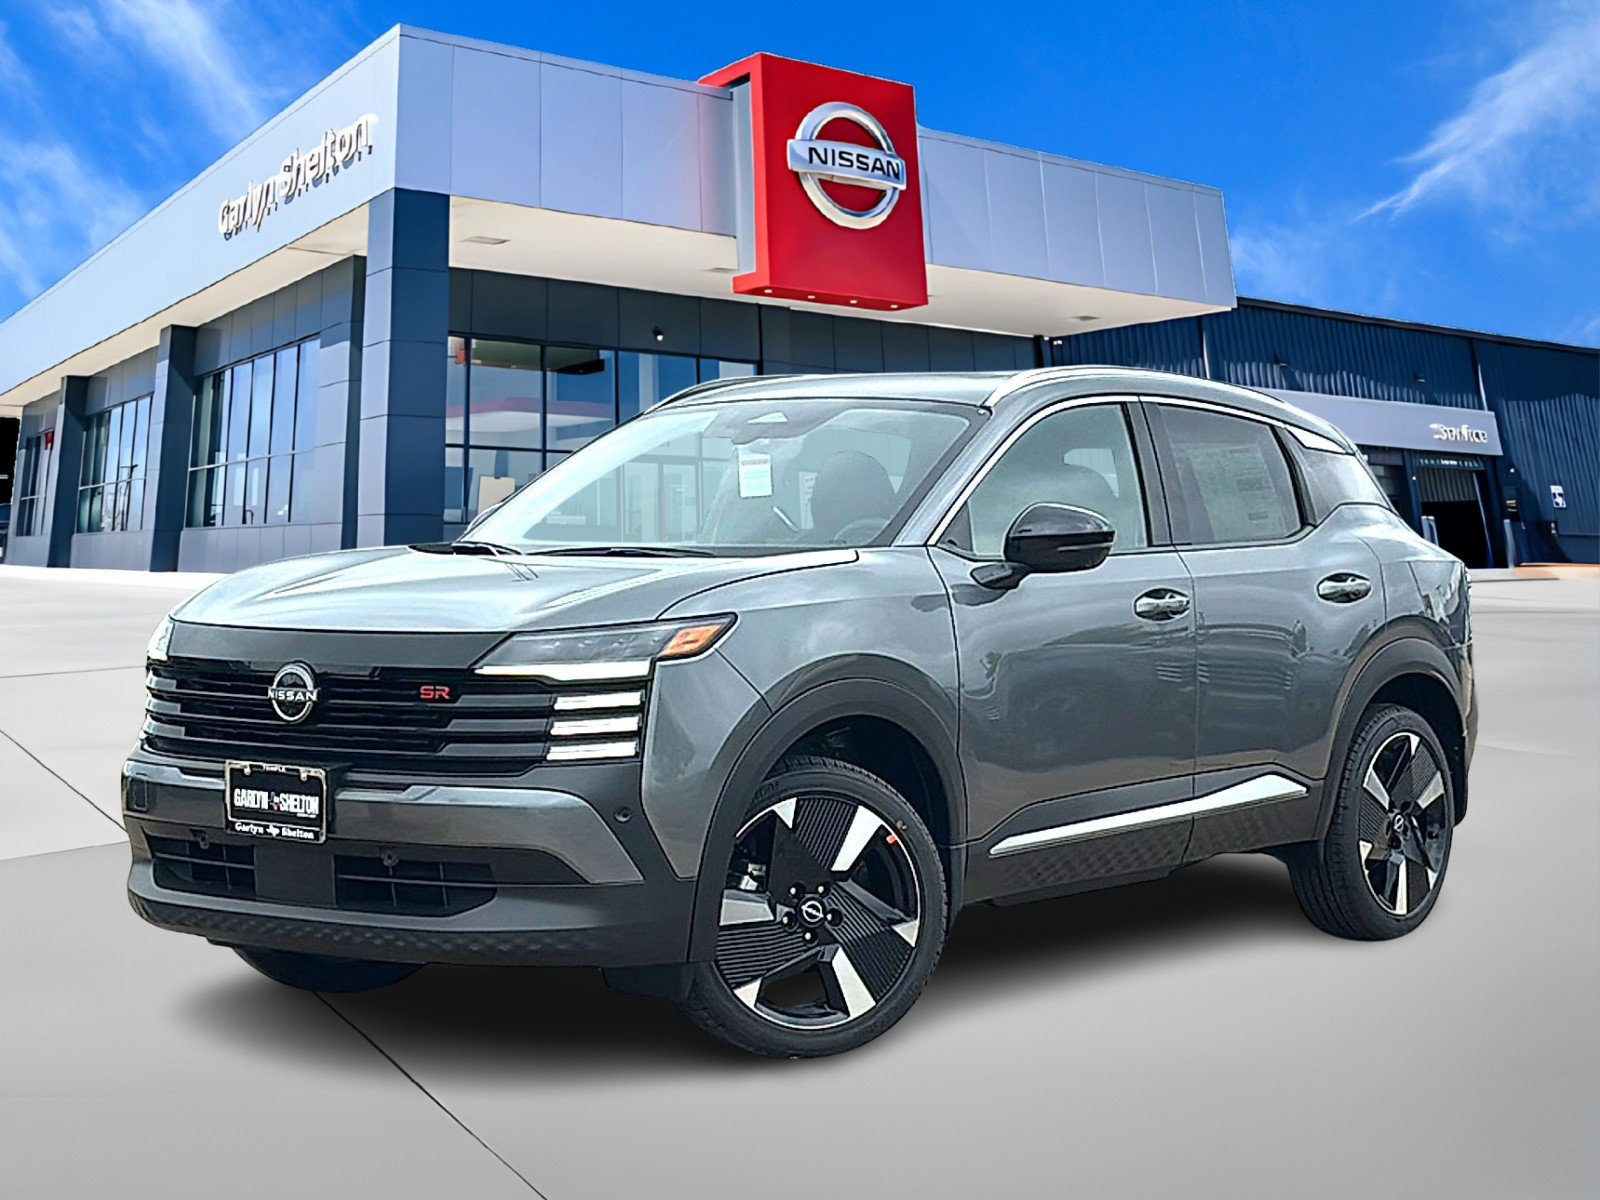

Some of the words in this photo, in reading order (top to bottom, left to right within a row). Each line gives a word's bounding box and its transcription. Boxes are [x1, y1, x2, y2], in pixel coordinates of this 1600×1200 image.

[808, 146, 901, 180] NISSAN
[268, 688, 318, 702] NISSAN
[419, 685, 451, 700] SR
[279, 793, 320, 815] SHELTON
